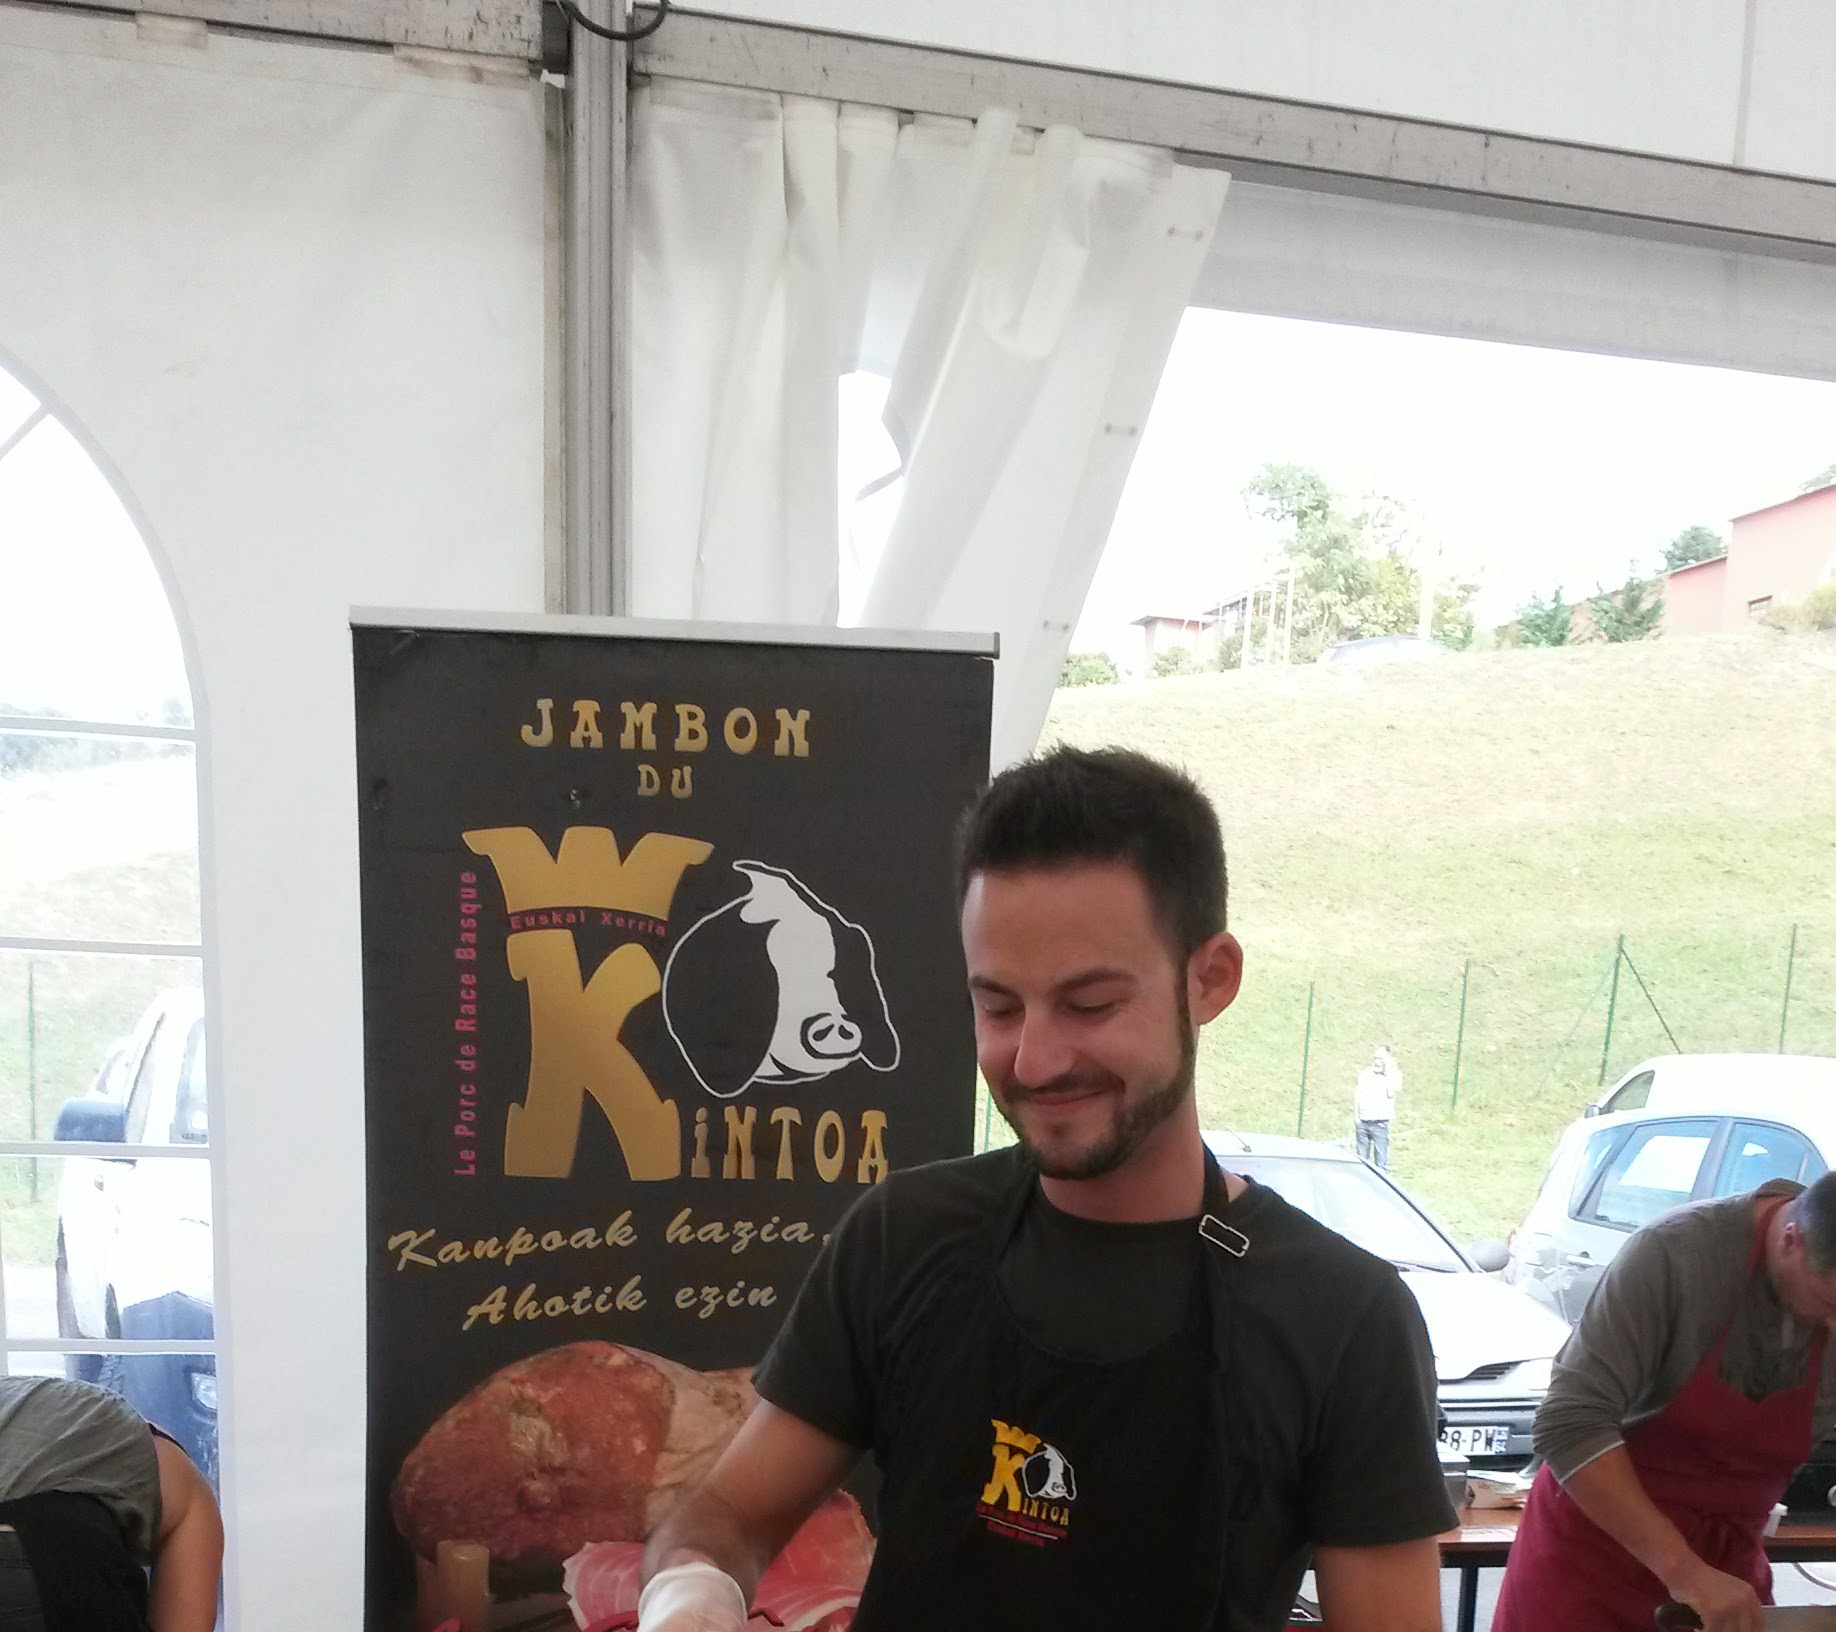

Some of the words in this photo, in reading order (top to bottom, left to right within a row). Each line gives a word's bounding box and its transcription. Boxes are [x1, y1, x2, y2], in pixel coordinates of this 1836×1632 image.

[520, 698, 812, 758] JAMBON
[637, 763, 694, 800] DU
[456, 871, 482, 960] Basque
[510, 909, 586, 930] Euskal
[601, 909, 667, 937] Xerria
[455, 973, 477, 1032] Race
[455, 1041, 477, 1071] de
[454, 1083, 477, 1137] Porc
[454, 1149, 476, 1176] Le
[387, 1209, 639, 1272] Kanpoak
[461, 1274, 648, 1332] Ahotik
[674, 1280, 778, 1320] ezin
